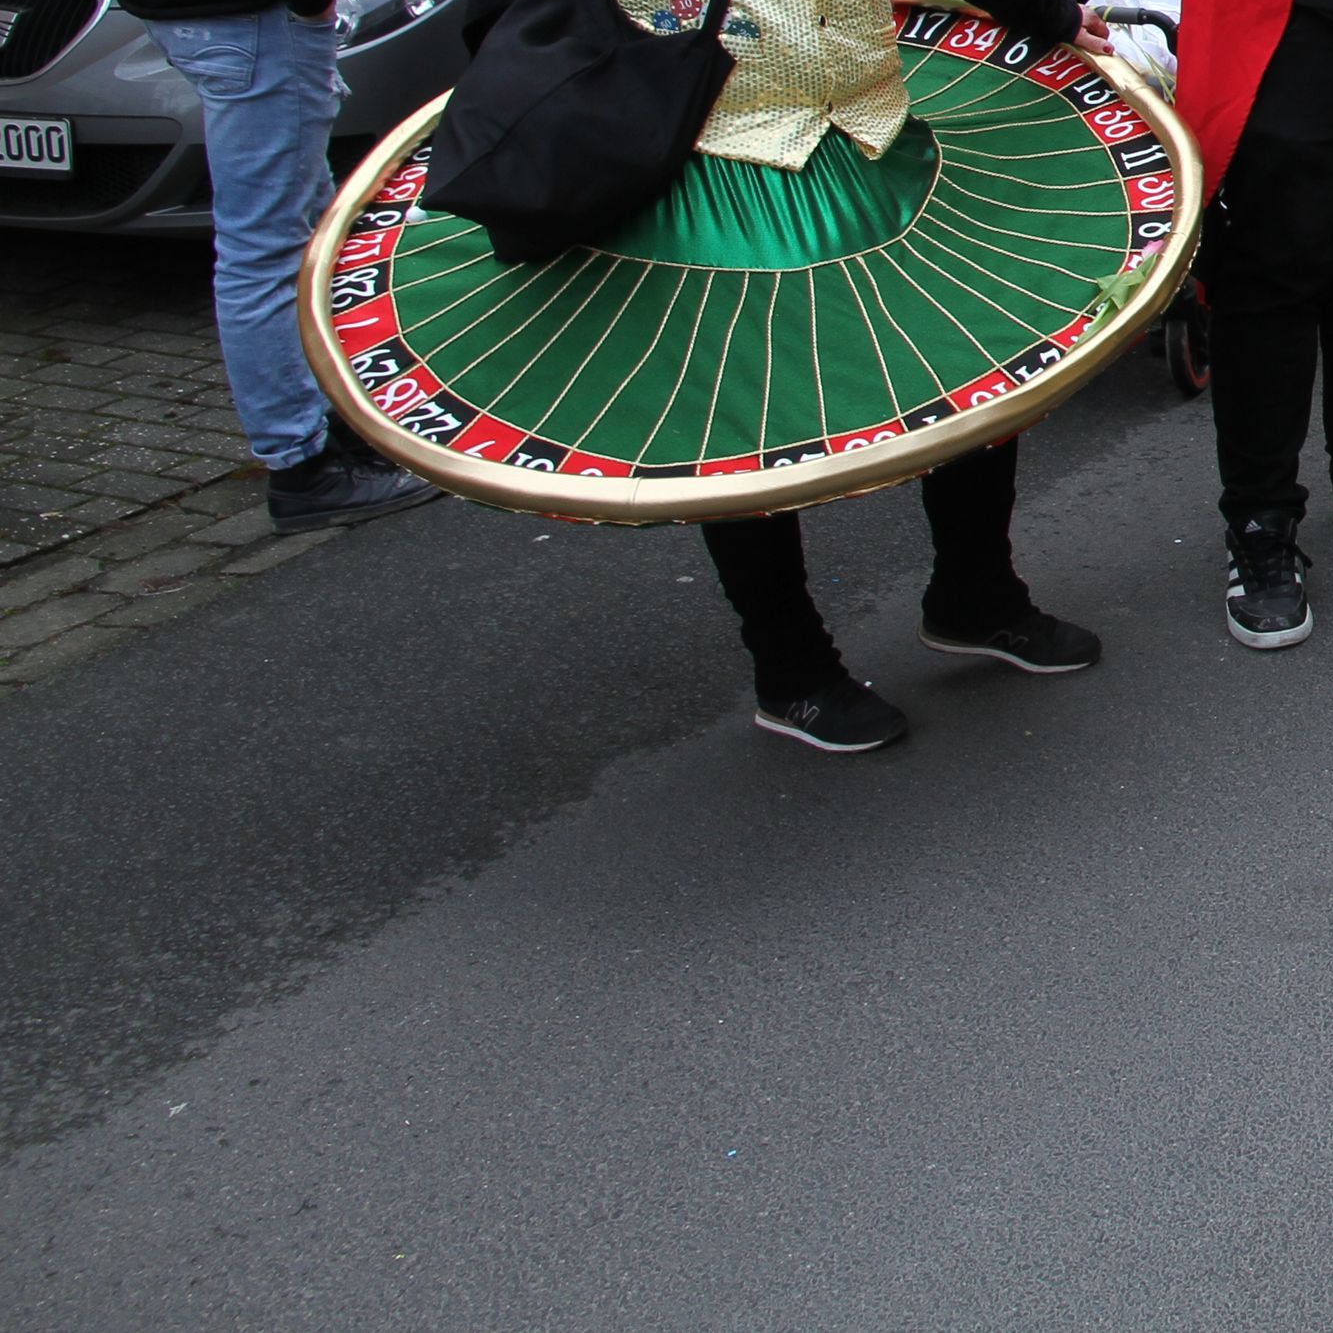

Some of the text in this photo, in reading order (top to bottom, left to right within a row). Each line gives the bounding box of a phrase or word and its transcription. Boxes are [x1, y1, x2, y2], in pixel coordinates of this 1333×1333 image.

[905, 12, 951, 40] 17
[950, 20, 1000, 52] 34
[1004, 36, 1031, 65] 6
[1036, 49, 1079, 81] 27
[1074, 72, 1112, 105] 13
[1094, 100, 1144, 139] 36
[0, 124, 65, 163] 000
[1121, 144, 1167, 170] 11
[1138, 176, 1174, 210] 30
[360, 210, 402, 227] 3
[338, 232, 387, 266] 12
[331, 268, 380, 309] 28
[351, 348, 400, 391] 29
[400, 401, 463, 443] 22
